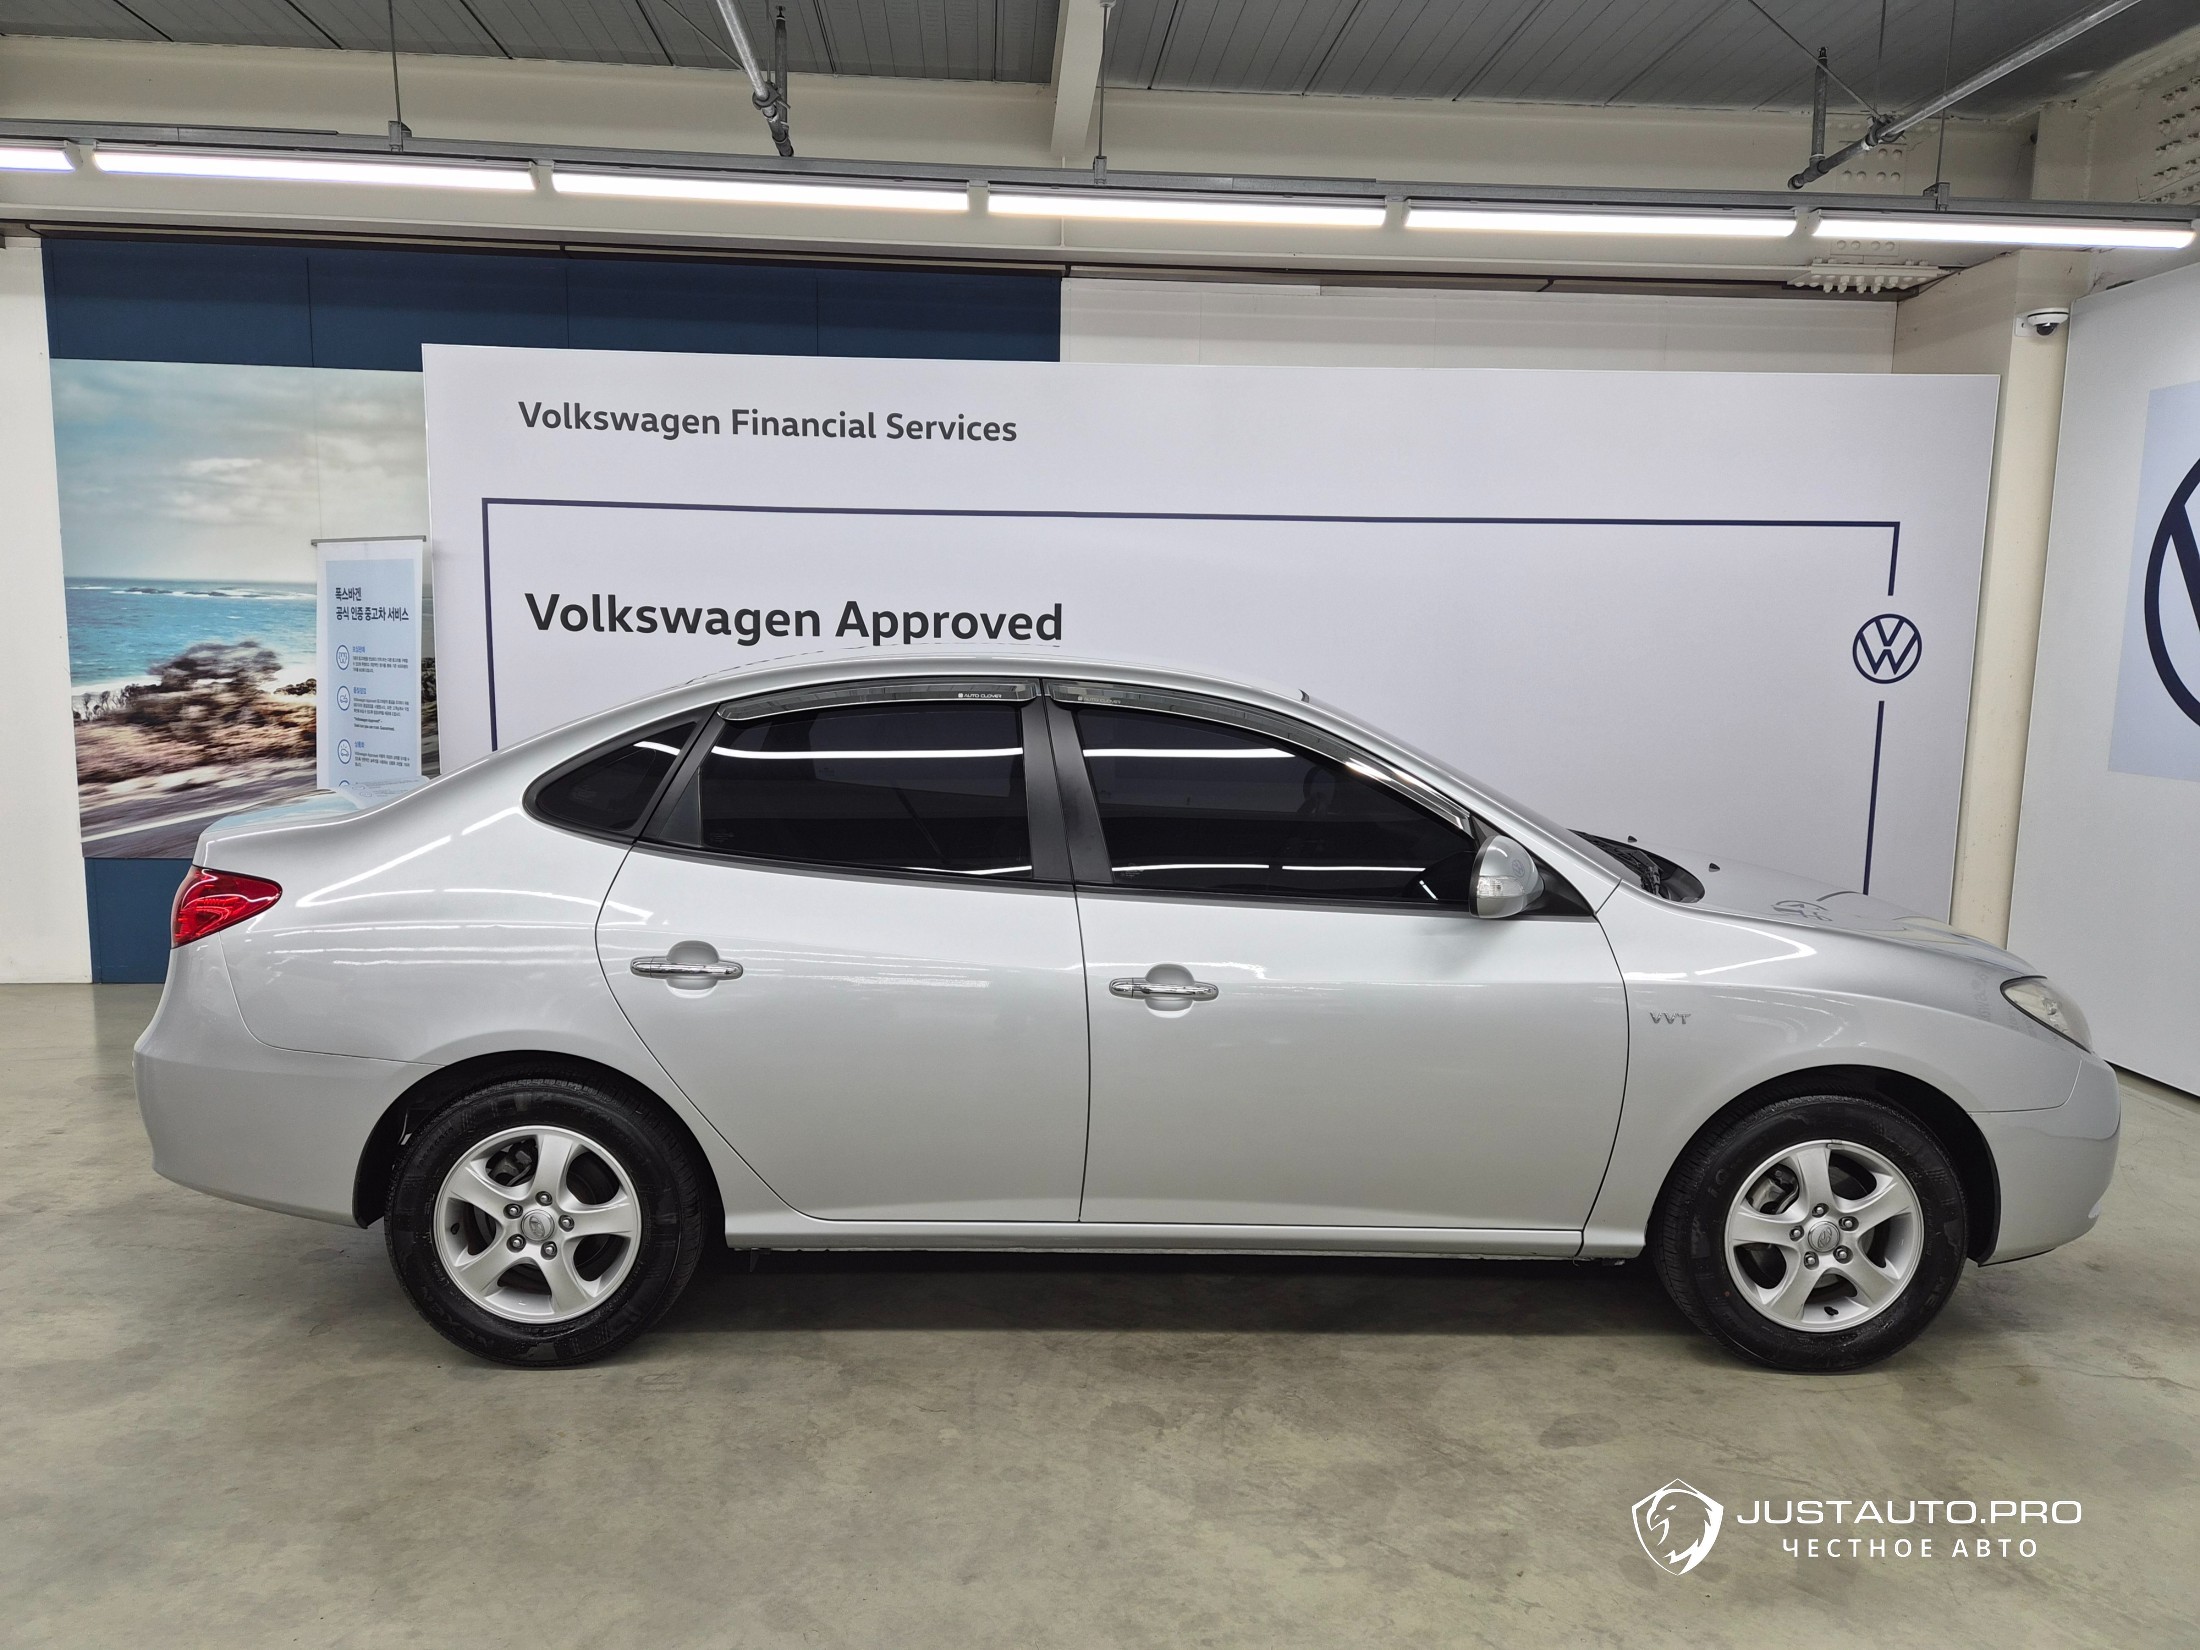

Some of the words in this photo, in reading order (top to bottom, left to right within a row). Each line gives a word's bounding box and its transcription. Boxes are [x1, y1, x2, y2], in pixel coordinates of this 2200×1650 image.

[518, 402, 720, 440] Volkswagen
[731, 409, 876, 439] Financial
[886, 413, 1017, 442] Services
[335, 587, 362, 602] 폭스바겐
[336, 606, 350, 621] 공식
[351, 606, 364, 621] 인증
[364, 606, 386, 621] 중고차
[387, 606, 409, 622] 서비스
[525, 593, 821, 646] Volkswagen
[835, 600, 1062, 646] Approved
[1649, 1012, 1691, 1025] VVT
